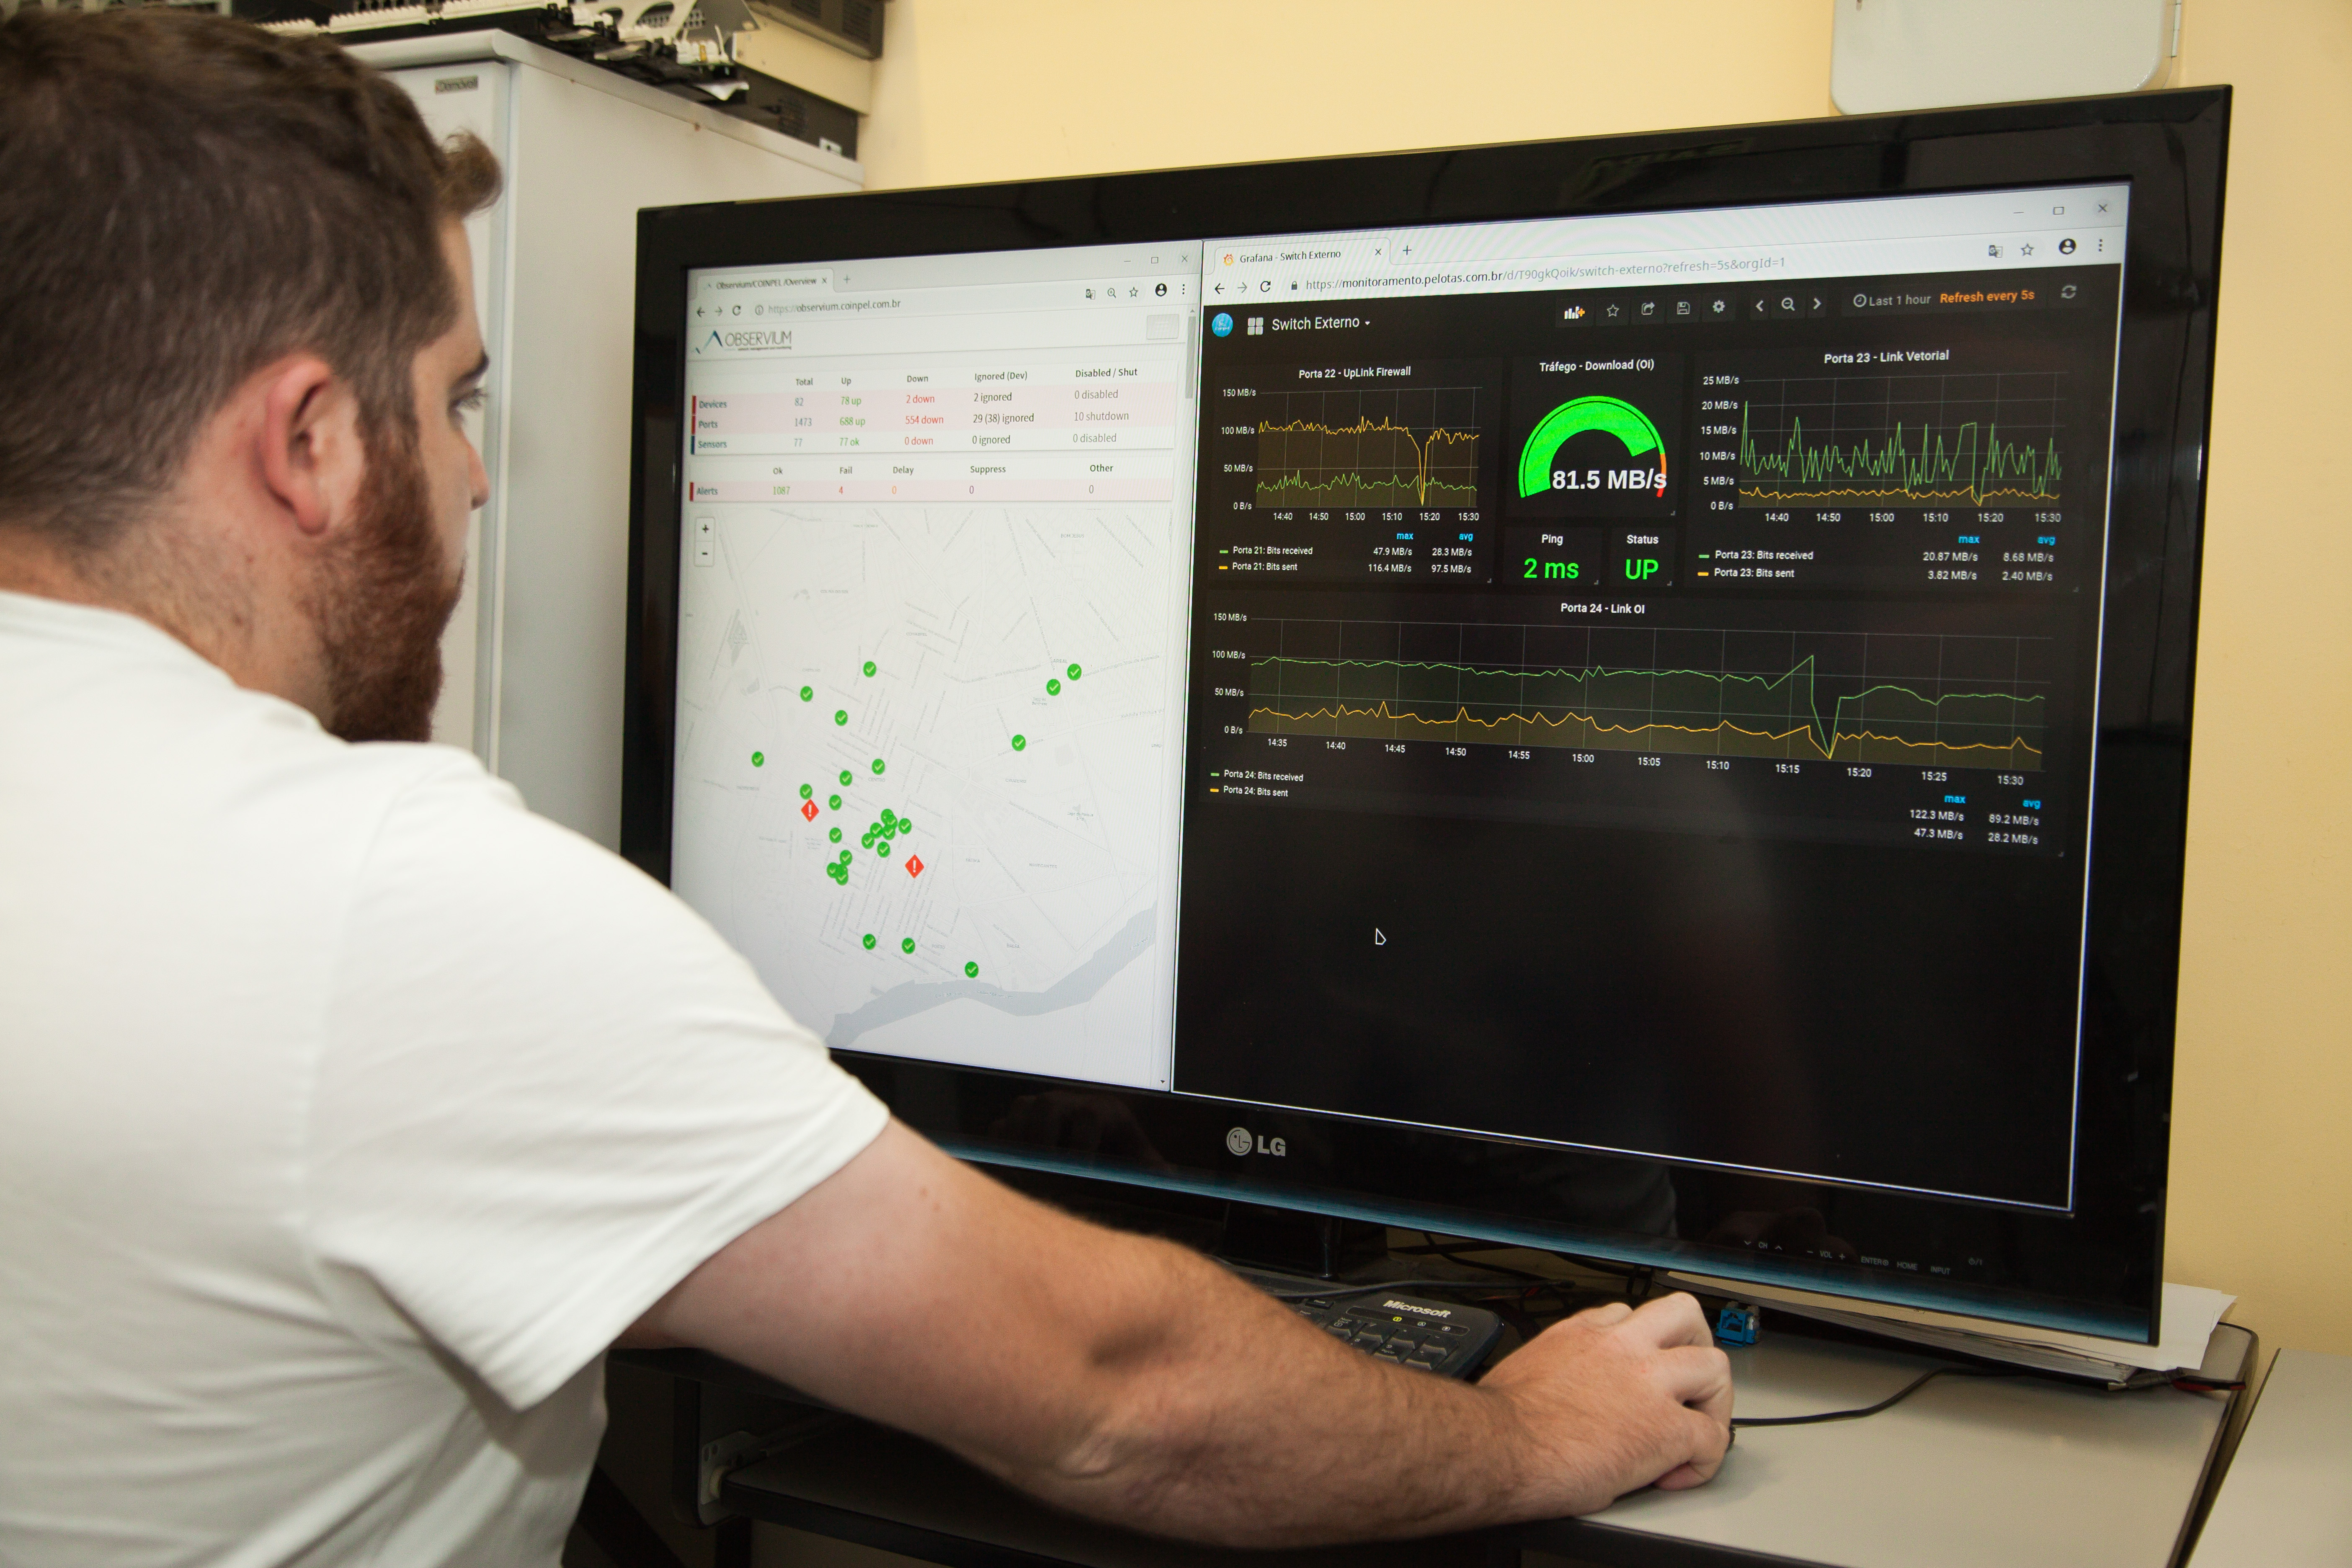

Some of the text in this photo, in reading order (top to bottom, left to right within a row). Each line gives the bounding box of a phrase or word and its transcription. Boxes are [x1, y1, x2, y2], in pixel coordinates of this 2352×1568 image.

[1240, 250, 1341, 263] Grafana Switch Externo
[1869, 294, 1931, 306] Last 1 hour
[1939, 290, 2035, 304] Refresh every 5s
[1272, 316, 1360, 330] Switch Externo
[725, 330, 792, 347] OBSERVIUM
[1824, 350, 1950, 364] Porta 23 Link Vetorial
[1540, 362, 1576, 374] Tráfego
[1585, 359, 1634, 370] Download
[795, 368, 1138, 386] Total Up Down Ignored (Dev) Disabled Shut
[1298, 366, 1411, 379] Porta 22 UpLink Firewall
[699, 400, 728, 409] Devices
[841, 396, 850, 405] 78
[851, 397, 862, 406] up
[906, 395, 911, 404] 2
[912, 395, 935, 404] down
[973, 393, 979, 402] 2
[980, 392, 1012, 404] ignored
[1074, 390, 1080, 399] 0
[1081, 389, 1119, 399] disabled
[698, 420, 718, 429] Ports
[839, 417, 853, 426] 688
[855, 418, 866, 427] up
[905, 415, 920, 424] 554
[921, 416, 944, 424] down
[972, 414, 983, 423] 29
[984, 413, 1000, 425] (38)
[1001, 413, 1034, 424] ignored
[1074, 412, 1084, 421] 10
[1086, 411, 1130, 421] shutdown
[1235, 426, 1255, 435] MB/s
[698, 440, 727, 449] Sensors
[839, 437, 848, 446] 77
[850, 437, 860, 446] ok
[904, 436, 910, 445] 0
[911, 436, 934, 445] down
[972, 436, 977, 444] 0
[979, 435, 1011, 446] ignored
[1073, 434, 1078, 443] 0
[1080, 433, 1117, 443] disabled
[773, 467, 783, 475] Ok
[839, 466, 853, 475] Fail
[892, 466, 914, 475] Delay
[970, 465, 1006, 475] Suppress
[1552, 469, 1667, 490] 81.5 MB/s
[696, 487, 718, 495] Alerts
[838, 486, 844, 494] 4
[1239, 501, 1252, 511] B/s
[1273, 512, 1480, 521] 14:40 14:50 15:00 15:10 15:20 15:30
[1765, 513, 2061, 522] 14:40 14:50 15:00 15:10 15:20 15:30
[1459, 532, 1473, 542] avg
[1541, 534, 1563, 545] Ping
[1626, 534, 1659, 544] Status
[2037, 535, 2056, 545] avg
[1233, 546, 1252, 554] Porta
[1267, 546, 1281, 555] Bits
[1282, 546, 1313, 555] received
[1373, 547, 1473, 557] 47.9 MB/s 28.3 MB/s
[1715, 550, 1813, 560] Porta 23: Bits received
[1923, 552, 2054, 563] 20.87 MB/s 8.68 MB/s
[1524, 558, 1579, 579] 2 ms
[1625, 559, 1659, 580] UP
[1560, 603, 1587, 613] Porta
[1589, 603, 1603, 613] 24
[1611, 603, 1632, 614] Link
[1267, 738, 2024, 785] 14:35 14:40 14:45 14:50 14:55 15:00 15:05 15:10 15:15 15:20 15:25 15:30
[1224, 770, 1304, 781] Porta 24: Bits received
[1944, 794, 2041, 809] max avg
[1910, 809, 2039, 826] 122.3 MB/s 89.2 MB/s
[1257, 1135, 1286, 1156] LG
[1819, 1250, 1833, 1258] VOL
[1860, 1256, 1882, 1265] ENTER
[1896, 1261, 1919, 1271] HOME
[1930, 1266, 1951, 1275] INPUT
[1382, 1300, 1452, 1318] Microsoft
